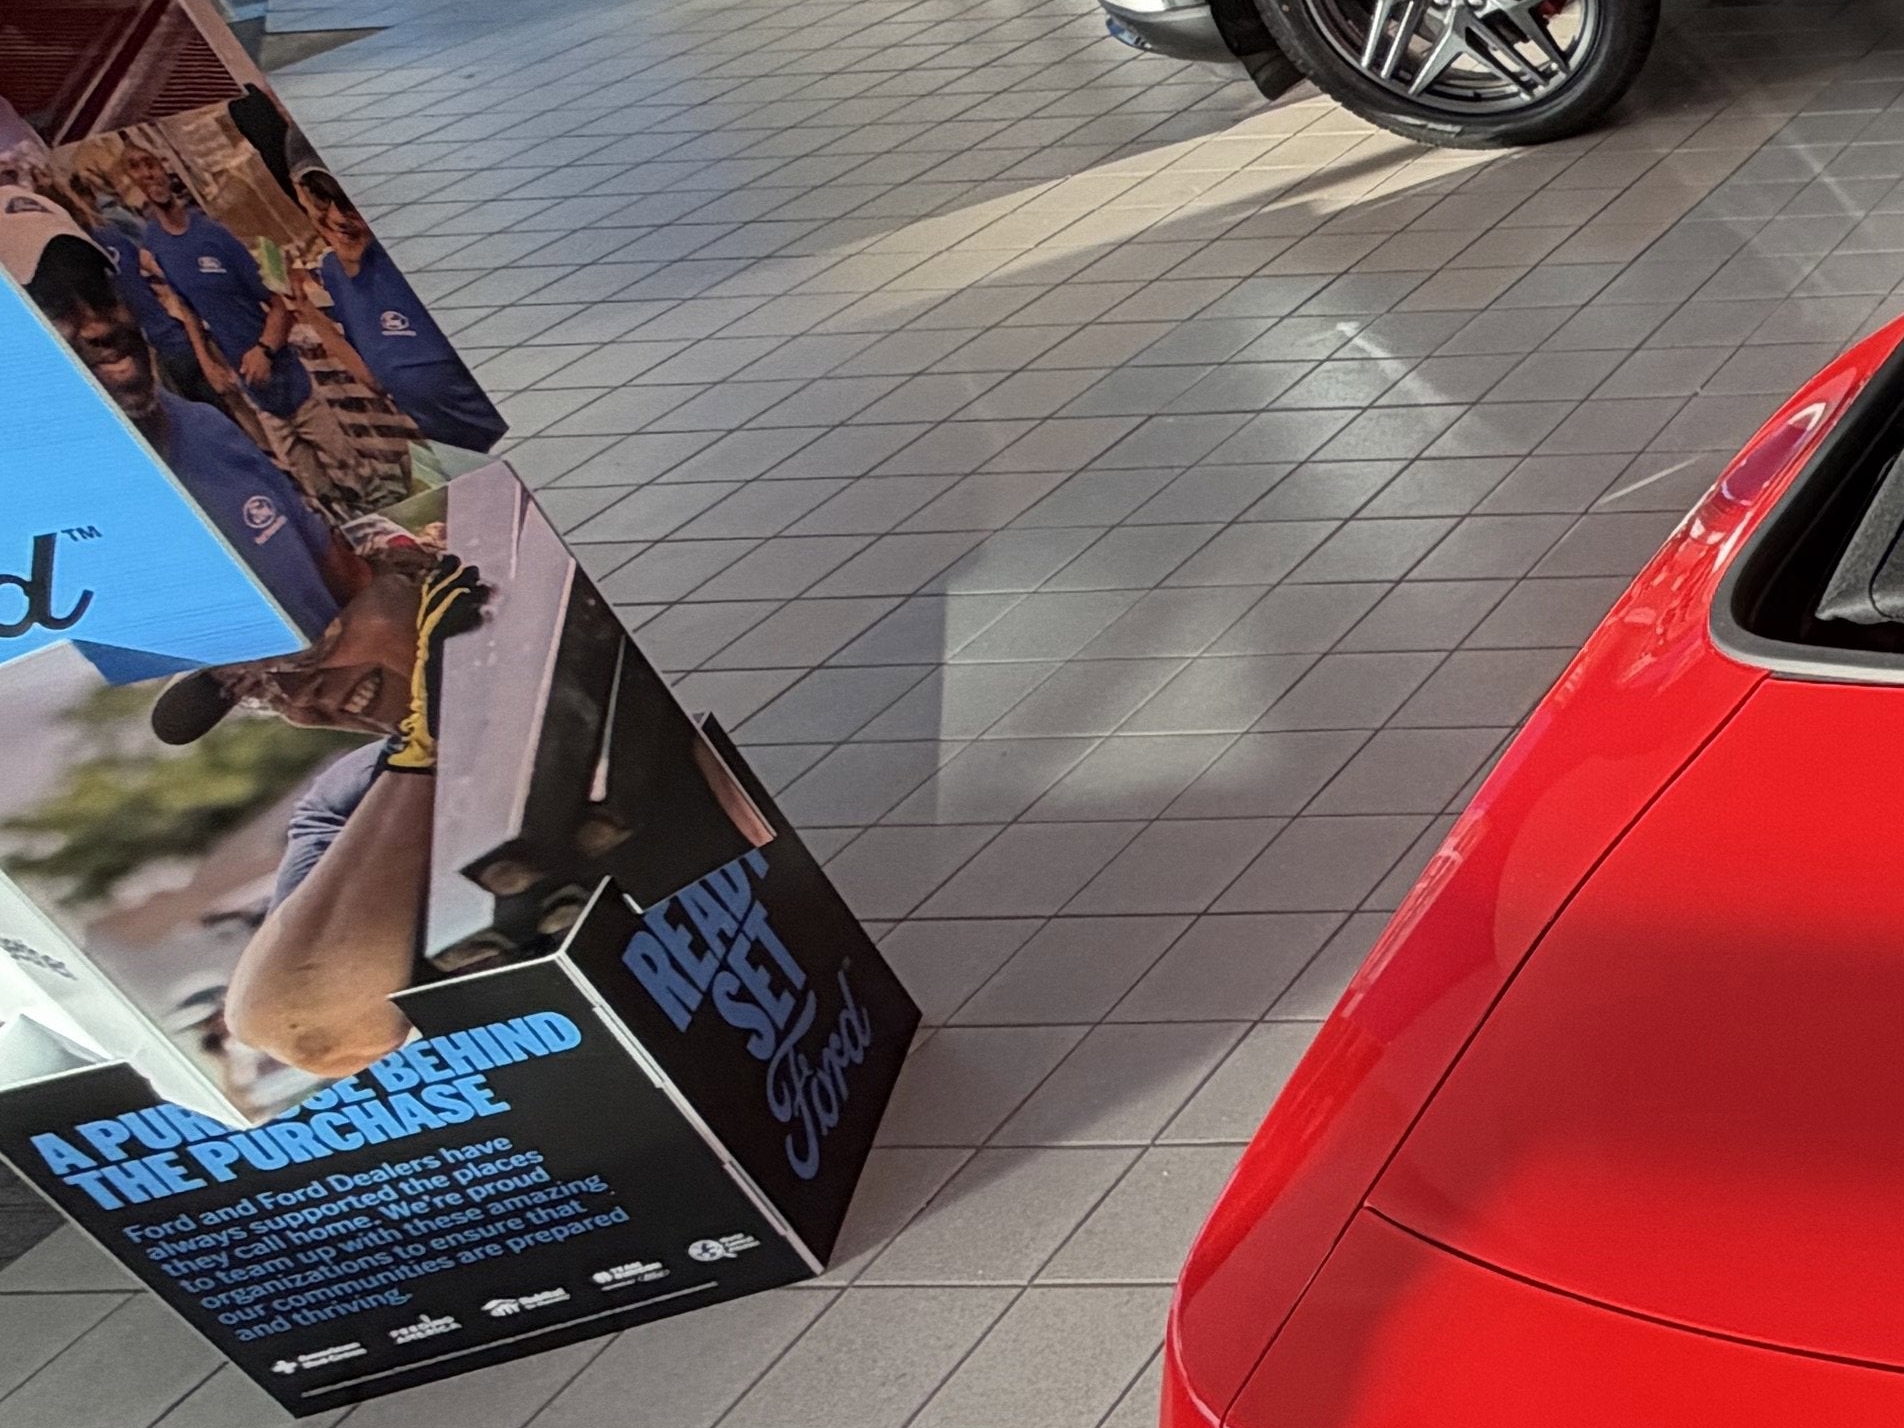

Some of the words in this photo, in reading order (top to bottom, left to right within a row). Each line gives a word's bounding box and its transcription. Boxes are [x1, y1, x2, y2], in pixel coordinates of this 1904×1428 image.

[712, 899, 807, 1061] SET
[30, 1132, 98, 1175] A
[368, 1011, 582, 1093] BEHIND
[766, 956, 871, 1181] Ford
[62, 1151, 208, 1210] THE
[186, 1074, 512, 1183] PURCHASE
[123, 1213, 197, 1243] Ford
[199, 1198, 257, 1225] and
[256, 1180, 328, 1210] Ford
[326, 1155, 442, 1192] Dealers
[439, 1137, 513, 1164] have
[146, 1225, 248, 1260] always
[249, 1184, 399, 1234] supported
[398, 1172, 450, 1195] the
[452, 1150, 544, 1185] places
[161, 1251, 229, 1276] they
[235, 1233, 288, 1259] call
[286, 1215, 382, 1245] home.
[378, 1192, 465, 1221] We're
[466, 1165, 551, 1202] proud
[179, 1274, 216, 1293] to
[215, 1255, 295, 1285] team
[297, 1246, 337, 1265] up
[338, 1226, 403, 1253] with
[403, 1206, 485, 1236] these
[486, 1175, 609, 1215] amazing
[200, 1250, 394, 1310] organizations
[393, 1242, 427, 1260] to
[430, 1217, 526, 1250] ensure
[525, 1198, 589, 1225] that
[218, 1302, 267, 1326] our
[272, 1255, 456, 1312] communities
[456, 1243, 504, 1265] are
[505, 1205, 631, 1254] prepared
[235, 1316, 292, 1342] and
[291, 1286, 414, 1327] thriving.
